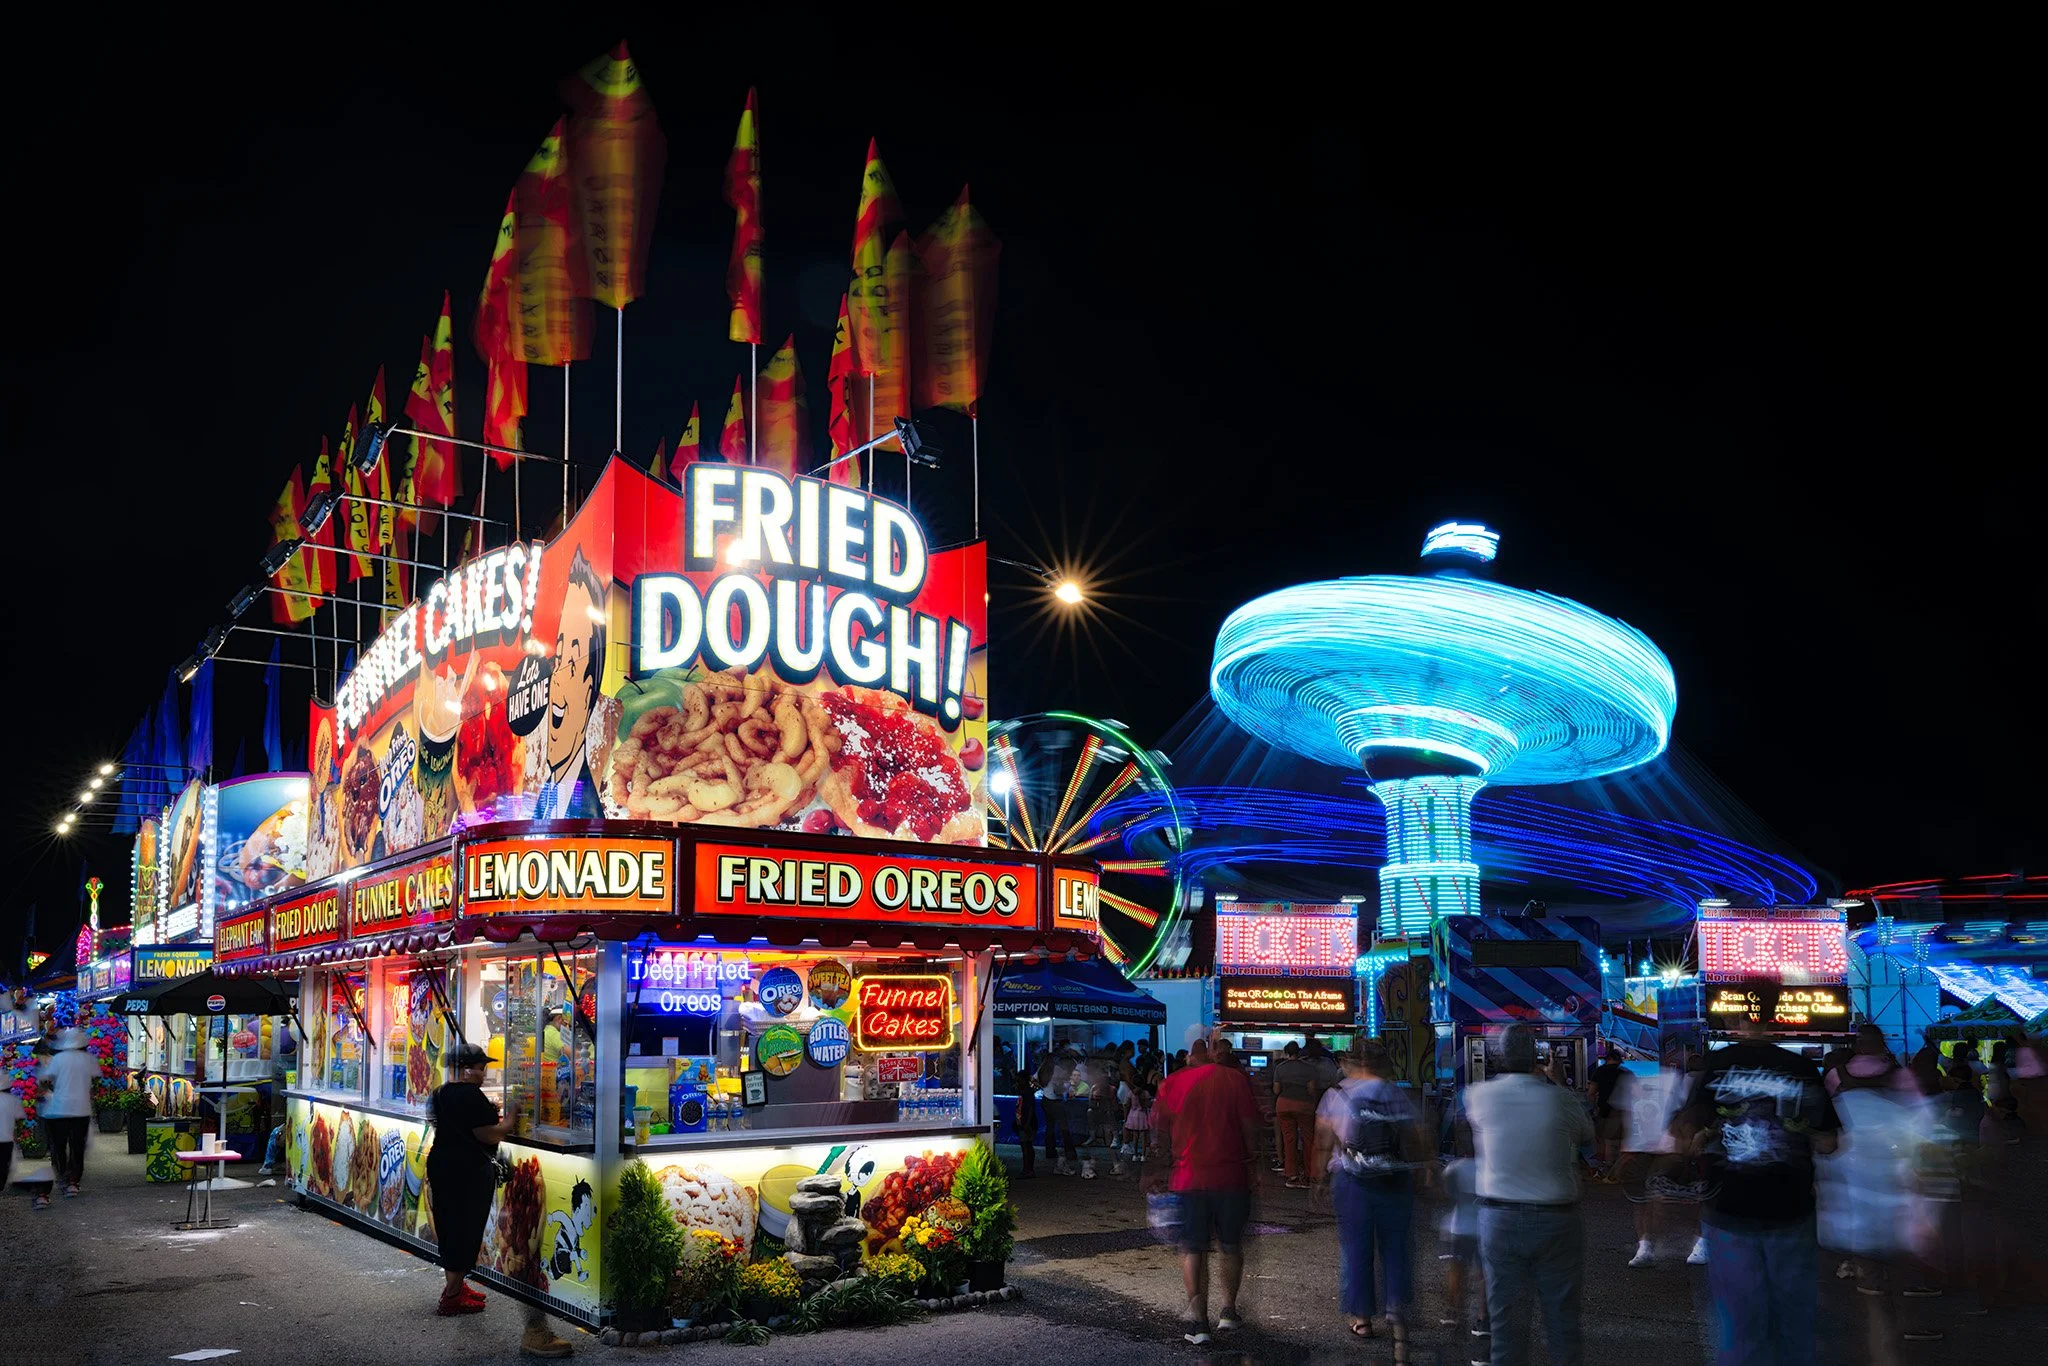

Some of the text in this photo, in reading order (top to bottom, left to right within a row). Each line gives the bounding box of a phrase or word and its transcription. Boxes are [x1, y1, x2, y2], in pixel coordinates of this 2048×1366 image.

[691, 466, 926, 594] FRIED
[335, 543, 543, 748] FUNNEL CAKES!
[639, 572, 972, 721] DOUGH!
[516, 657, 540, 690] Lets
[508, 677, 549, 723] HAVE ONE
[379, 739, 416, 814] OREO
[466, 849, 666, 899] LEMONADE
[718, 855, 1020, 915] FRIED OREOS
[354, 864, 453, 923] FUNNEL CAKES
[276, 896, 338, 942] FRIED DOUGH
[1703, 908, 1718, 918] Have
[1718, 909, 1731, 919] your
[1731, 909, 1751, 919] money
[1774, 908, 1789, 919] Have
[1790, 909, 1801, 920] your
[1802, 909, 1822, 920] money
[220, 921, 249, 952] ELEPHANT
[1217, 916, 1356, 967] TICKETS
[1699, 922, 1846, 974] TICKETS
[631, 960, 751, 985] Deep Fried
[809, 972, 850, 990] SWEET TEA
[1221, 966, 1352, 977] No refunds No refunds
[1705, 973, 1722, 982] No
[124, 999, 149, 1012] PEPSI
[410, 978, 430, 1010] OREO
[660, 991, 722, 1012] Oreos
[862, 983, 947, 1008] Funnel
[1227, 989, 1343, 1000] Scan QR Code On The Aframe
[1227, 1001, 1346, 1011] to Purchase Online With Credit
[1720, 991, 1745, 1001] Scan
[1796, 992, 1812, 1002] On
[1813, 991, 1834, 1002] The
[1054, 1003, 1166, 1019] WRISTBAND REDEMPTION
[1711, 1002, 1845, 1014] Aframe to rchase Online
[1775, 1013, 1809, 1023] Credit
[809, 1023, 849, 1044] BOTTLED
[868, 1011, 942, 1037] Cakes
[813, 1044, 846, 1062] WATER
[380, 1140, 406, 1180] OREO
